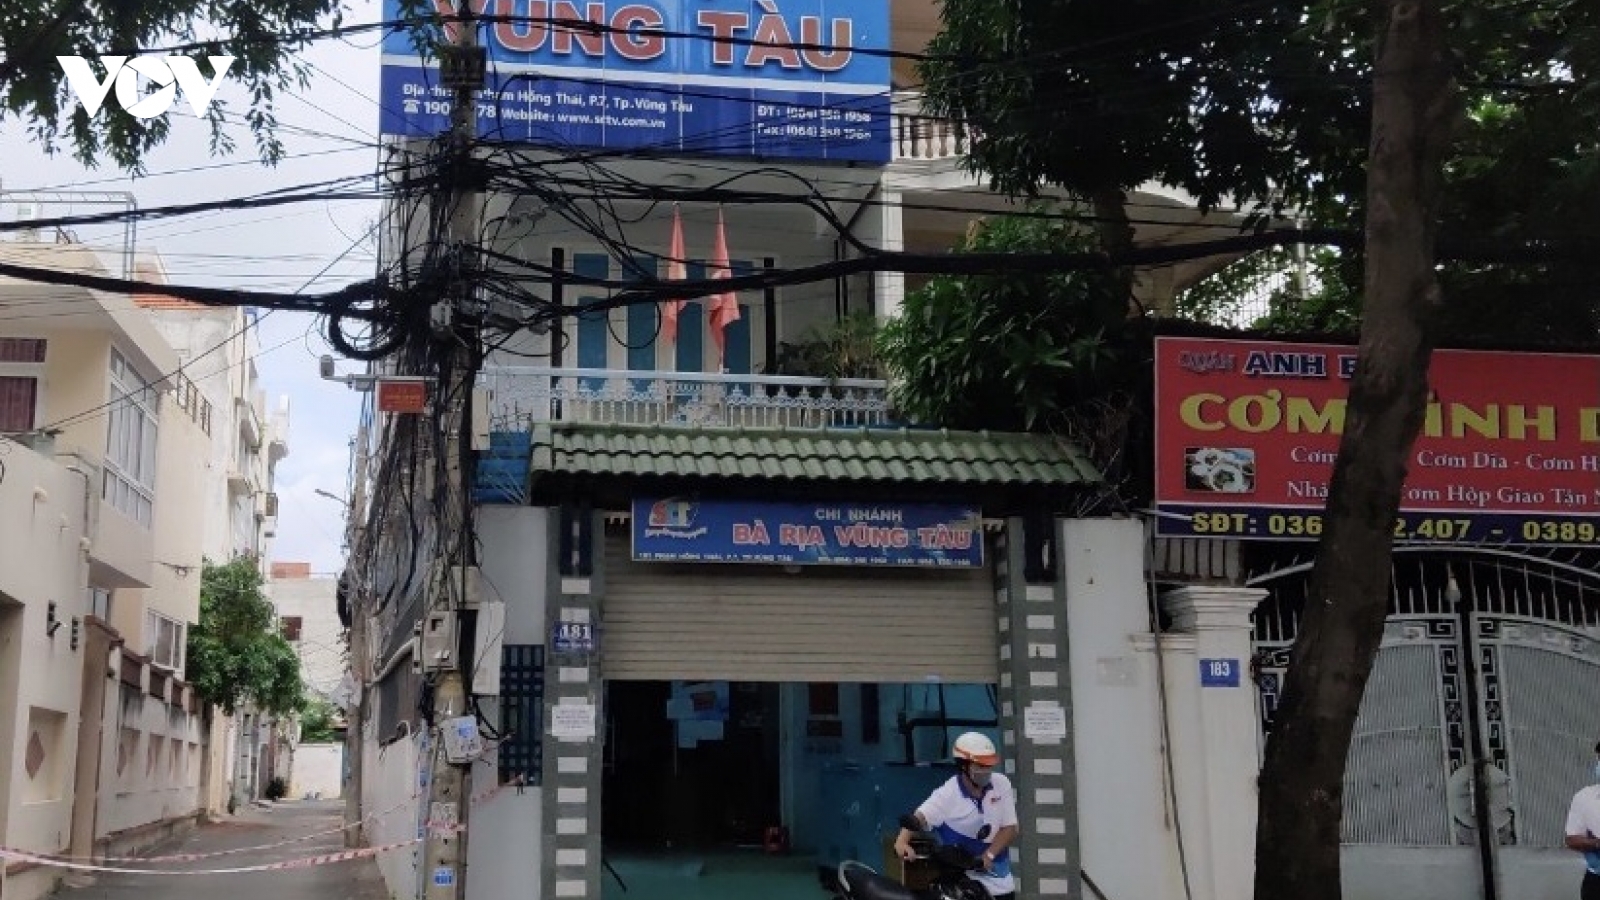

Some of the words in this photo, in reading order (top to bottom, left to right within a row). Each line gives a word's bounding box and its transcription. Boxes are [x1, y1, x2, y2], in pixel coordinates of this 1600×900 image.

[1242, 350, 1327, 377] ANH
[1180, 389, 1348, 435] CƠM
[1497, 486, 1545, 504] Giao
[815, 508, 841, 521] CHI
[848, 508, 903, 523] NHÁNH
[1192, 512, 1257, 534] SĐT:
[732, 519, 771, 545] BÀ
[1209, 661, 1231, 677] 183
